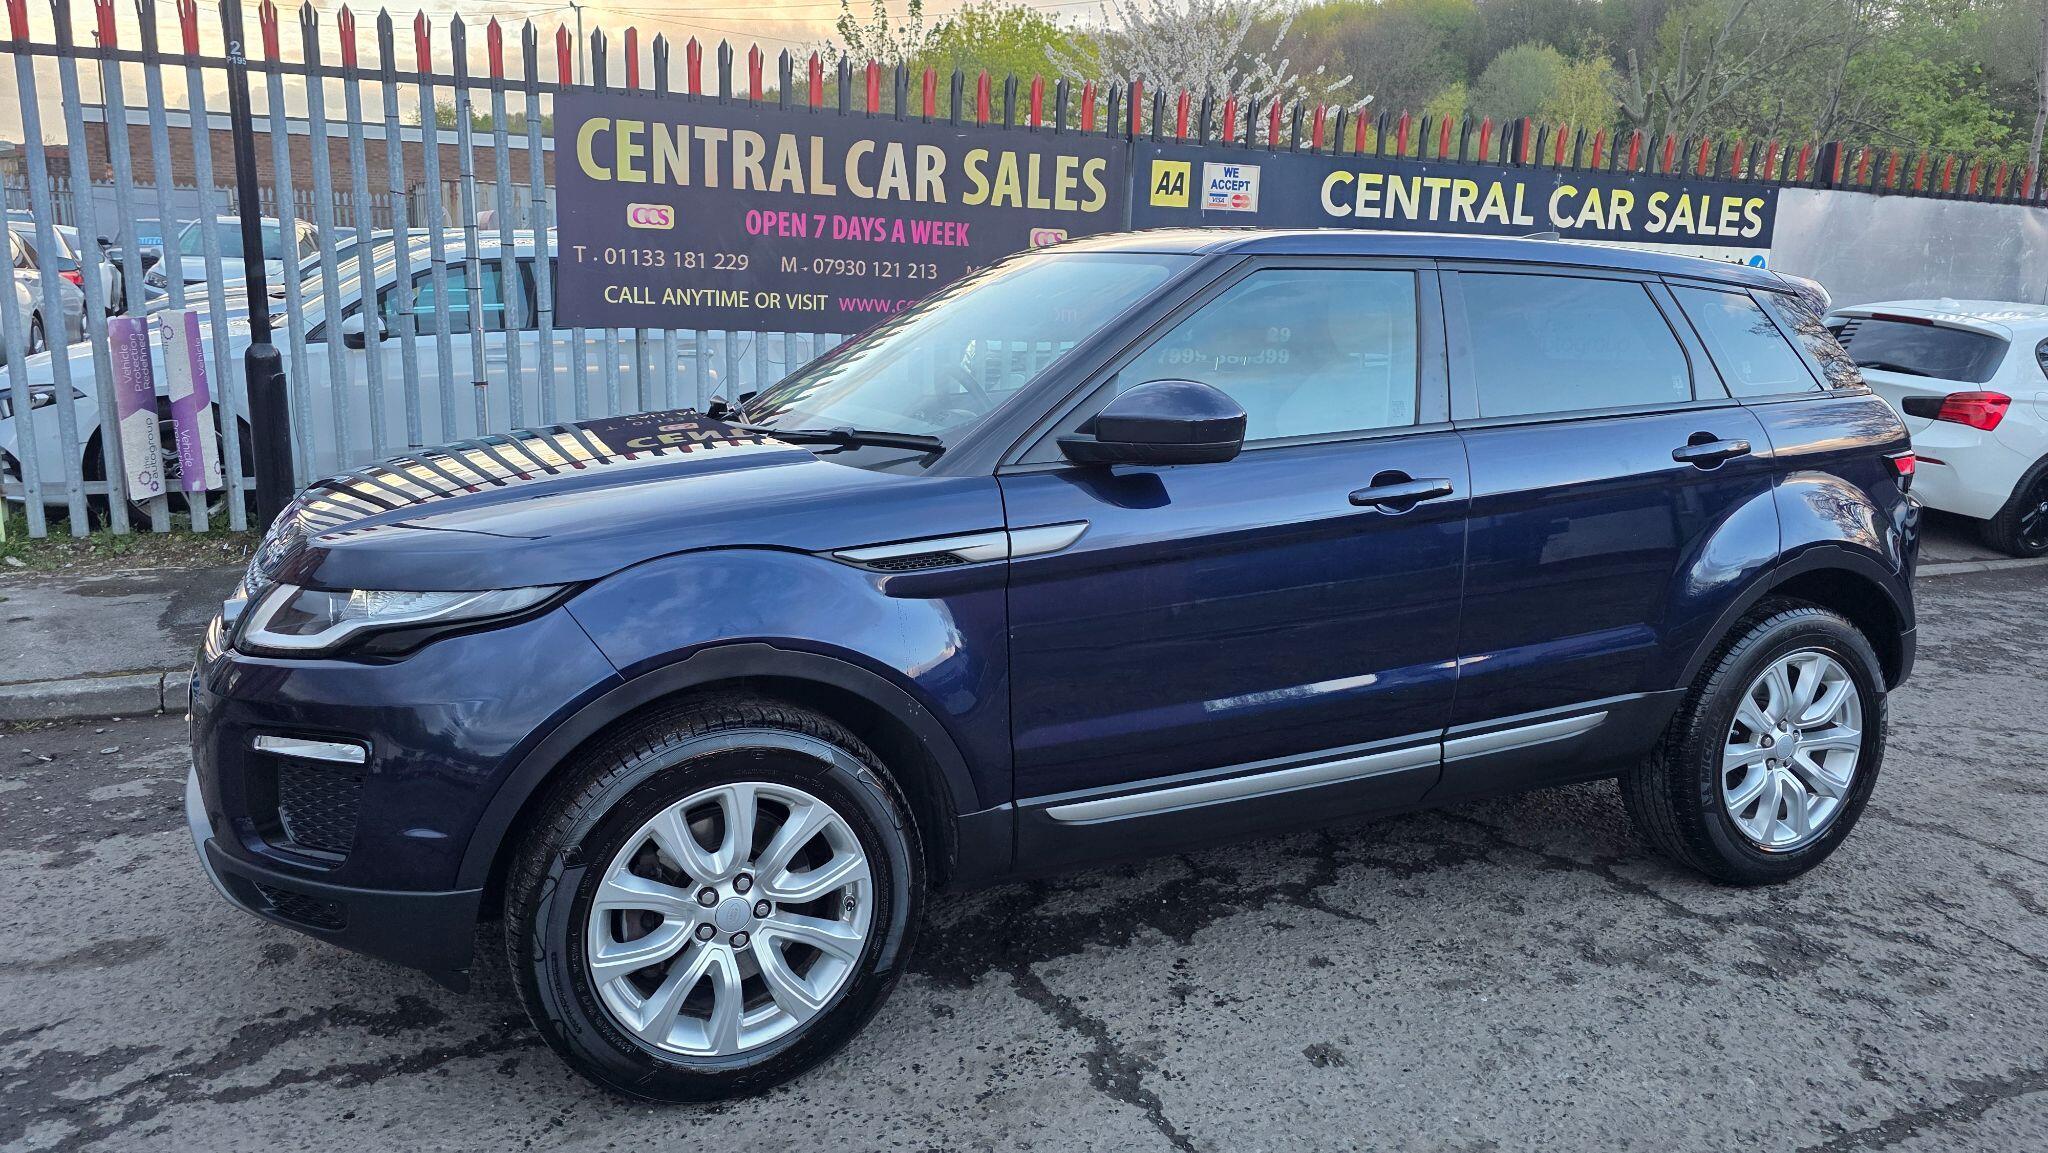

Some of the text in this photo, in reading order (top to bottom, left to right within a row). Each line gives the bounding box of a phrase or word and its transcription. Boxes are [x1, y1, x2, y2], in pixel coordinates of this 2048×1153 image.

[230, 40, 242, 55] 2
[576, 117, 1107, 214] CENTRAL CAR SALES
[1223, 167, 1240, 178] WE
[1155, 170, 1185, 196] AA
[1211, 179, 1250, 191] ACCEPT
[632, 207, 670, 226] CCS
[1320, 170, 1766, 239] CENTRAL CAR SALES
[745, 209, 970, 247] OPEN 7 DAYS A WEEK
[604, 247, 666, 267] 01133
[674, 251, 706, 269] 181
[712, 252, 749, 271] 229
[813, 258, 867, 277] 07930
[872, 261, 901, 278] 121
[908, 263, 938, 280] 213
[604, 285, 656, 305] CALL
[661, 287, 750, 308] ANYTIME
[755, 292, 781, 309] OR
[785, 293, 829, 312] VISIT
[118, 344, 132, 384] Vehicle
[129, 333, 143, 392] Protection
[145, 417, 159, 479] autogroup
[180, 429, 194, 468] Vehicle
